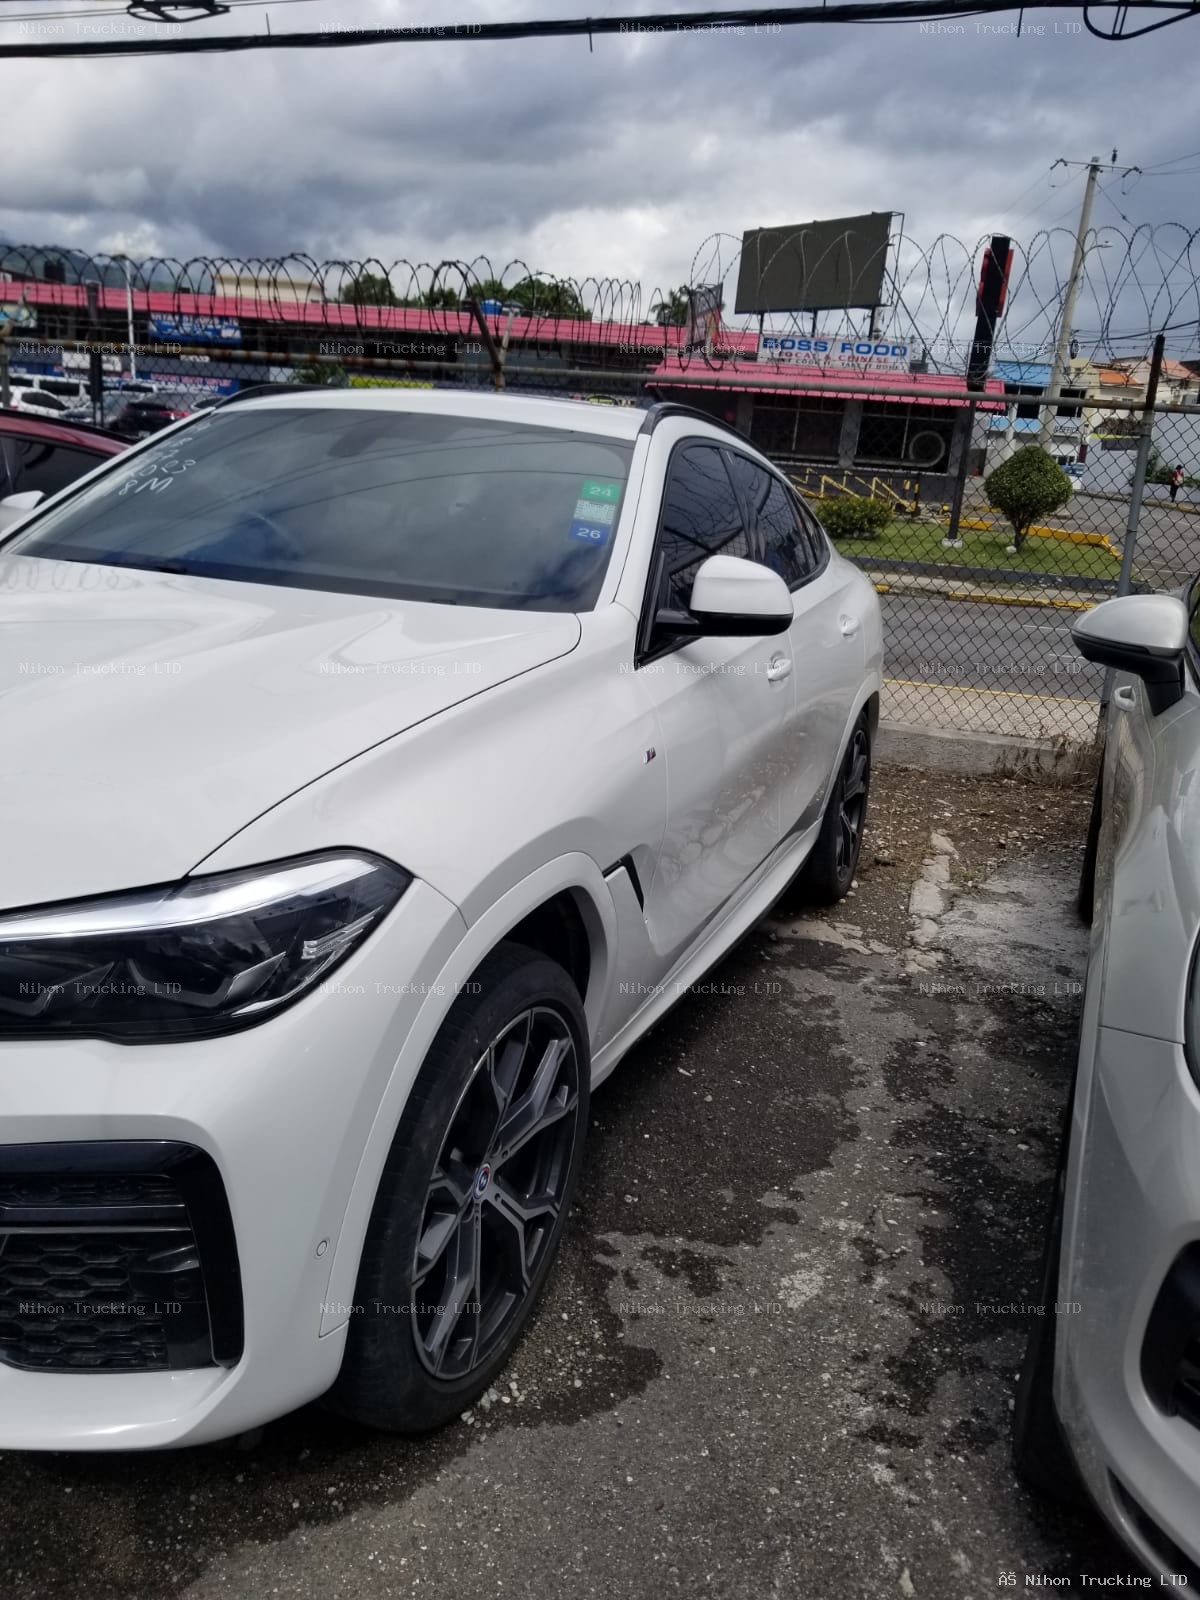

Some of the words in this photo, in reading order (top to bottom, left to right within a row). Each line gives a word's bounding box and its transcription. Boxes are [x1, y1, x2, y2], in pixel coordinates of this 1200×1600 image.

[841, 342, 908, 357] FOOD
[589, 486, 611, 497] 24
[576, 527, 601, 539] 26
